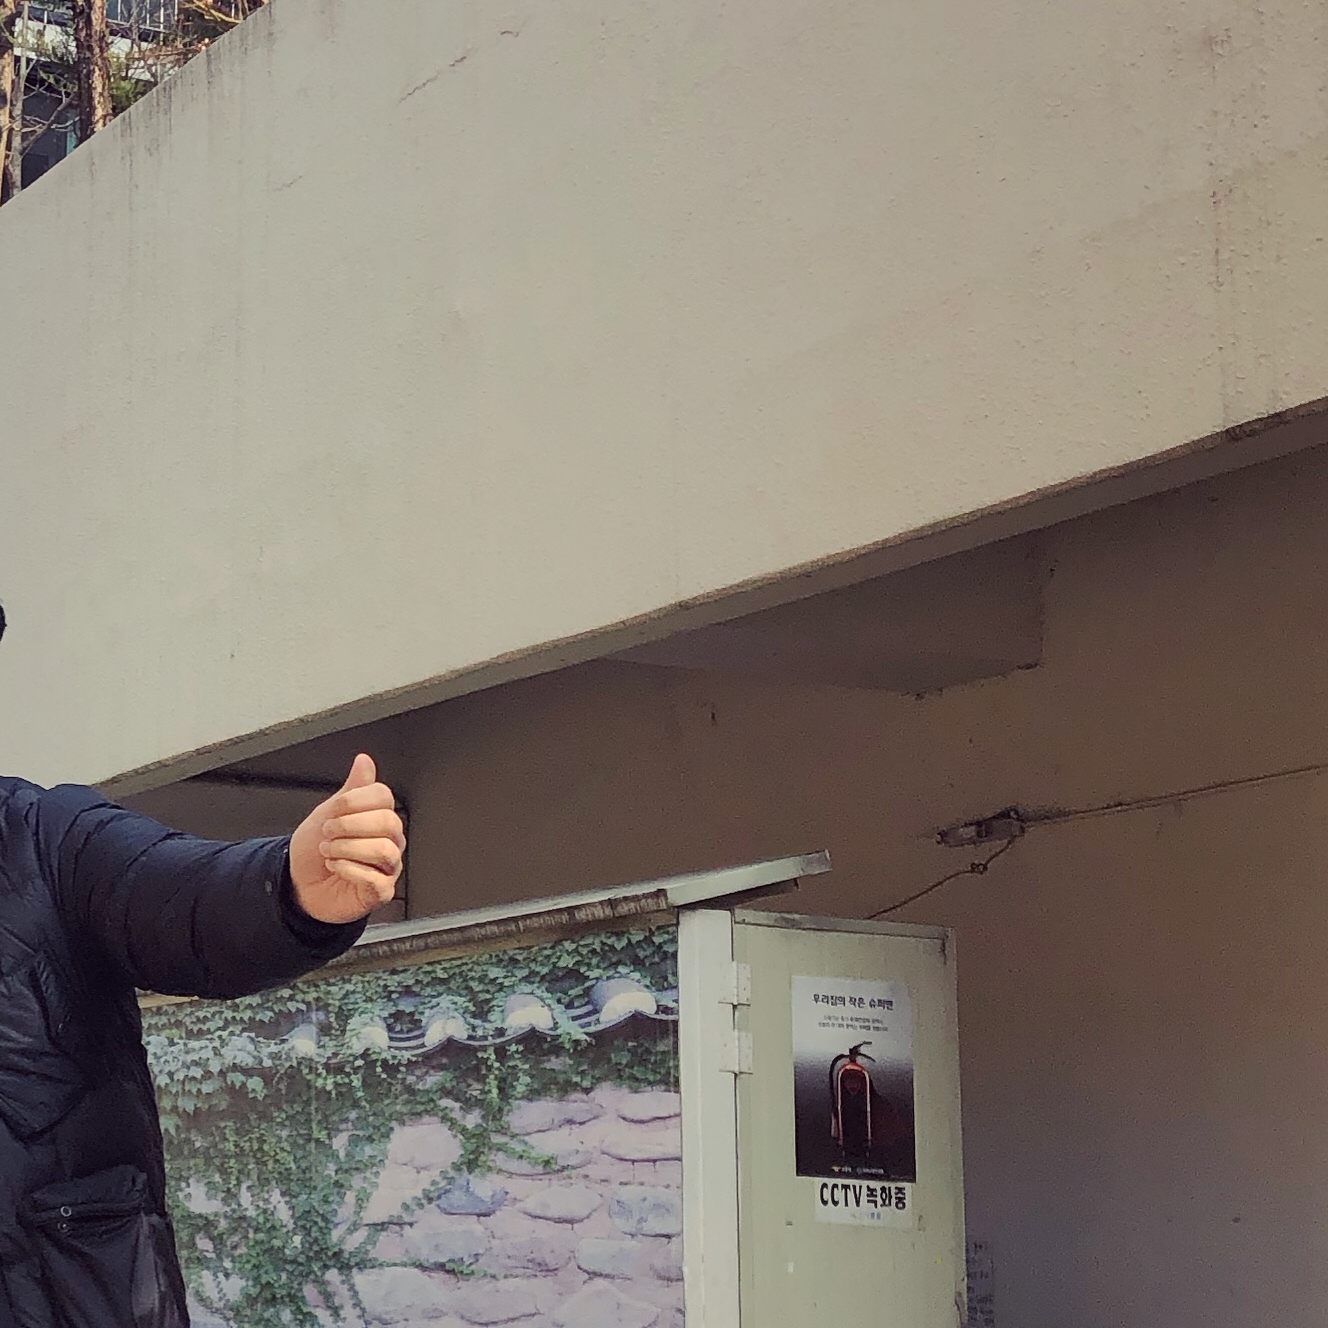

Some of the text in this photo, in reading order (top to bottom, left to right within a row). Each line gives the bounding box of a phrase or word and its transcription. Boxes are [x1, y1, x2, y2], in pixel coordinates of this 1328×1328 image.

[812, 993, 894, 1010] 우리집의 작은 슈퍼맨
[819, 1182, 907, 1211] CCTV 녹화중
